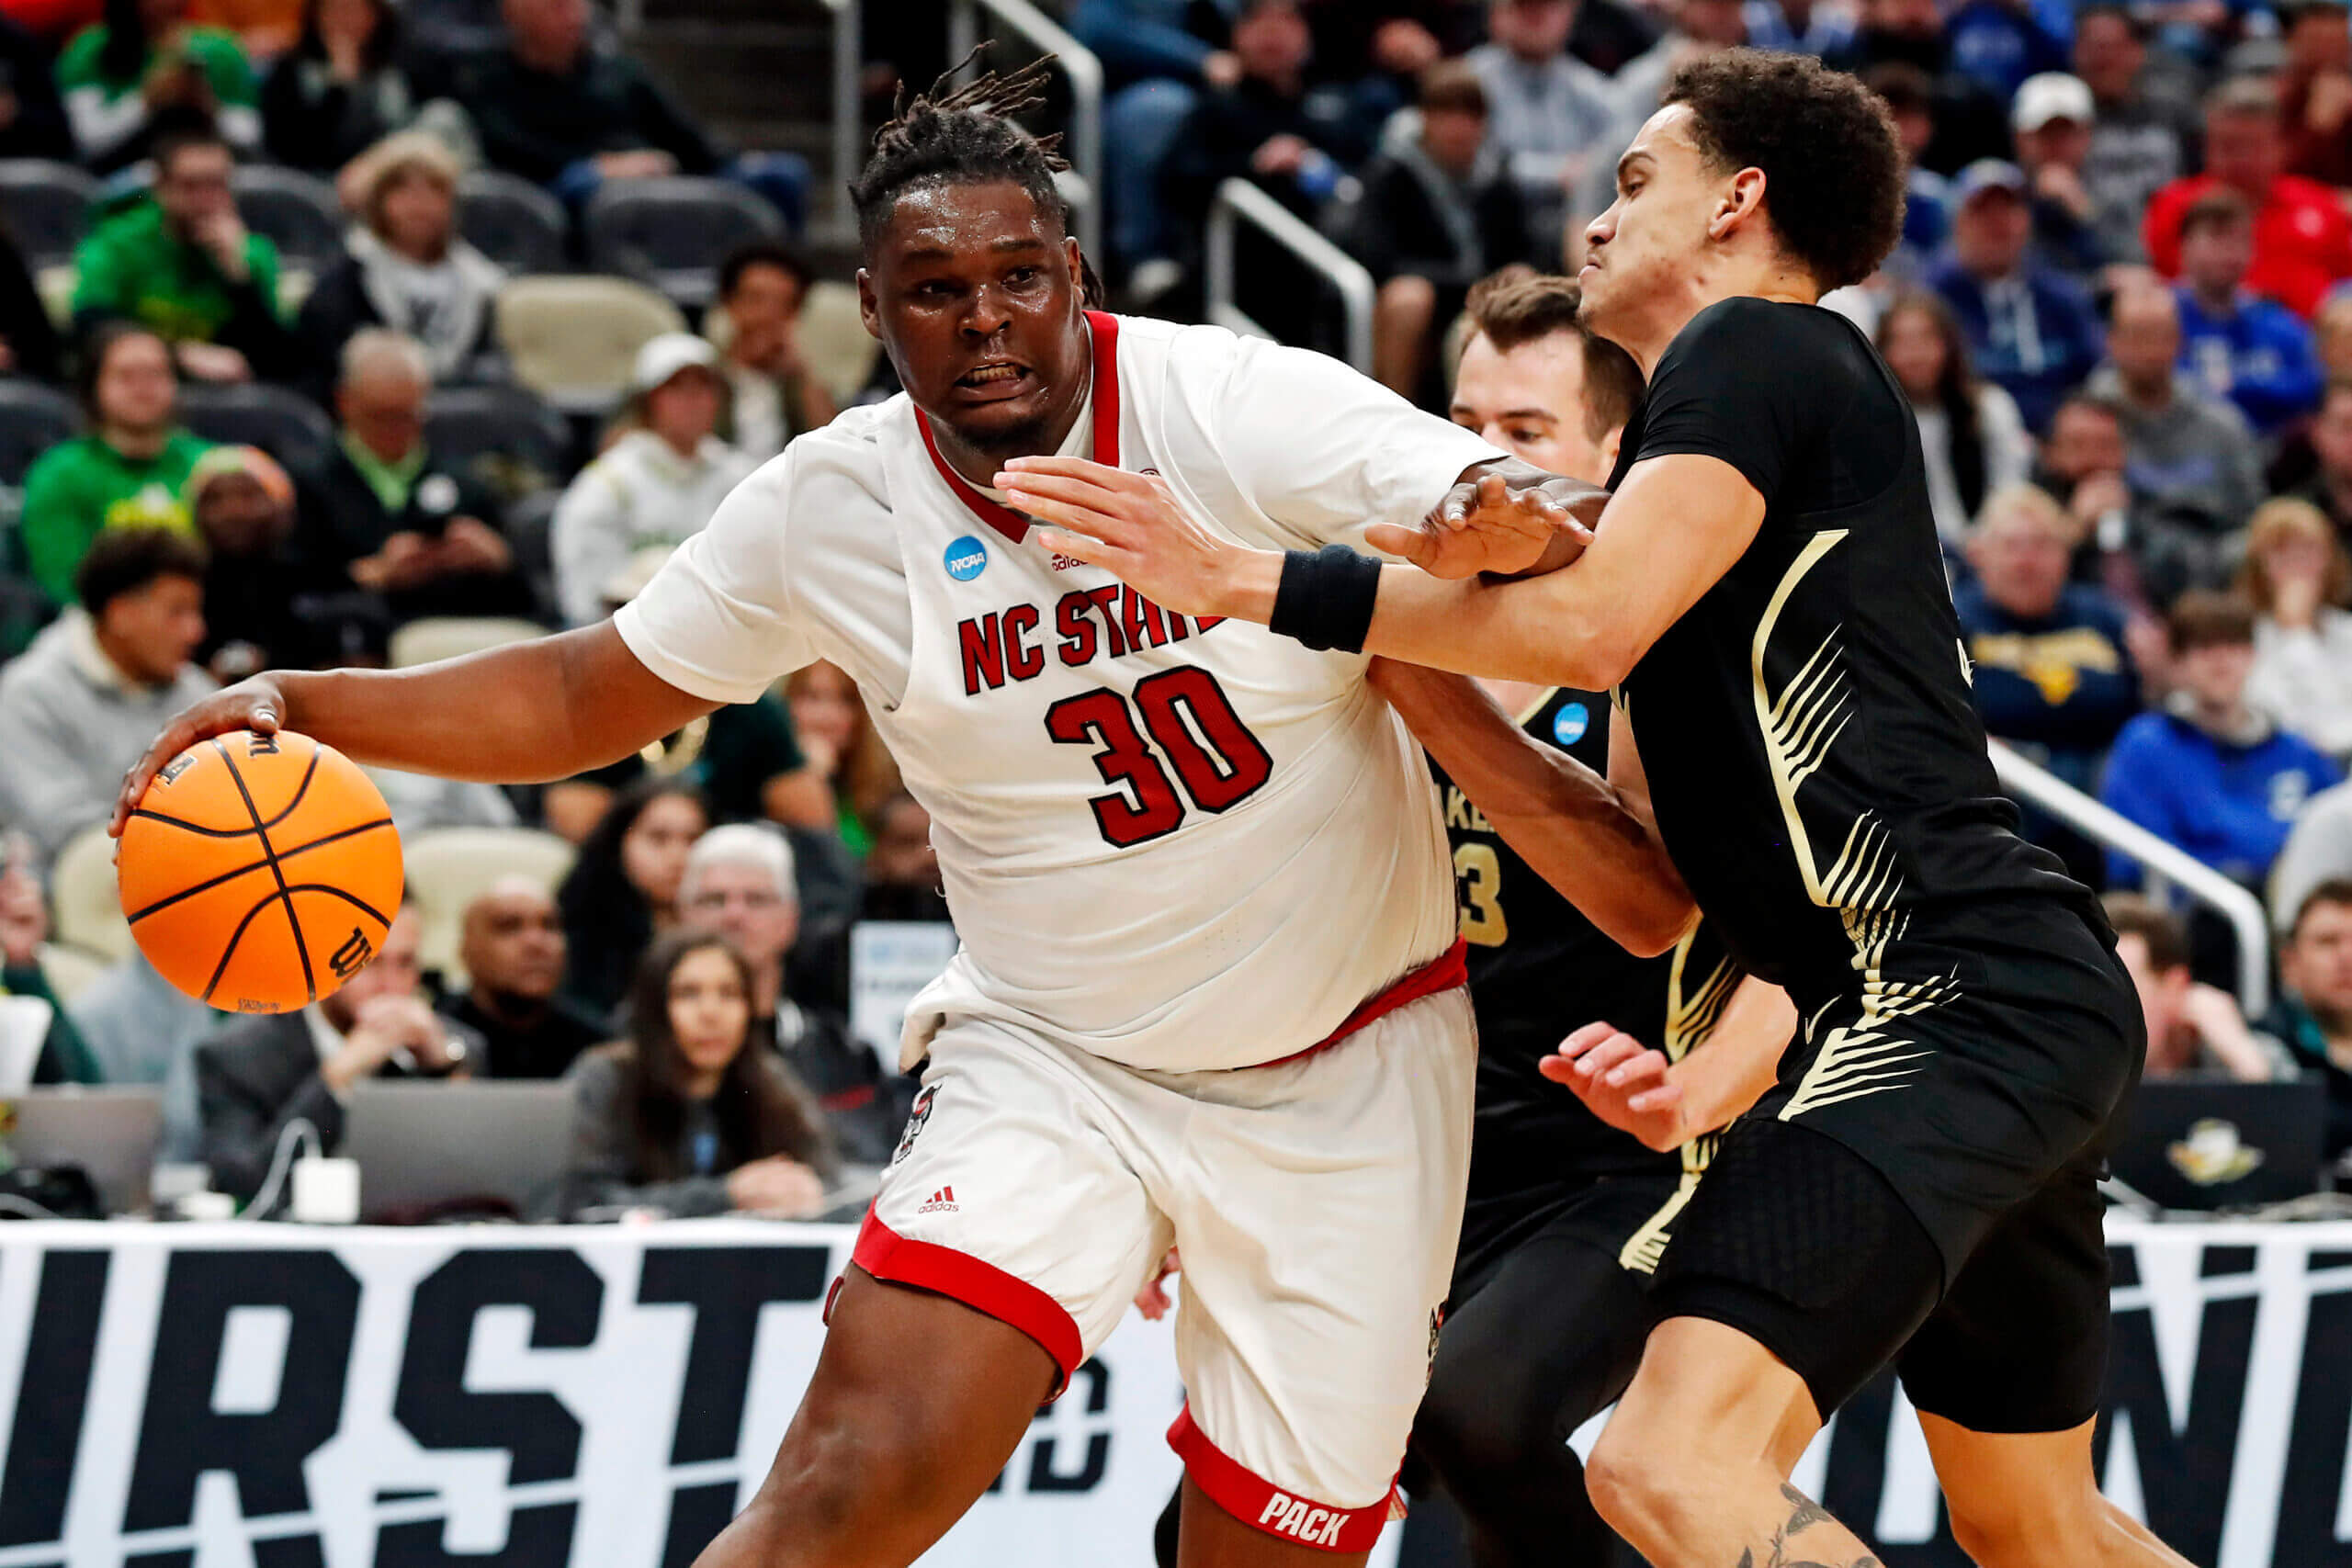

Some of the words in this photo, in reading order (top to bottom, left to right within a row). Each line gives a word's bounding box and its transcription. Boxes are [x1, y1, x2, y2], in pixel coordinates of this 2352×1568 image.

[950, 552, 986, 573] NCAA
[957, 603, 1046, 696] NC
[1055, 584, 1228, 667] STA
[1044, 664, 1273, 849] 30
[1453, 842, 1509, 947] 3
[919, 1201, 959, 1214] adidas
[0, 1247, 831, 1568] IRST
[1258, 1492, 1351, 1547] PACK
